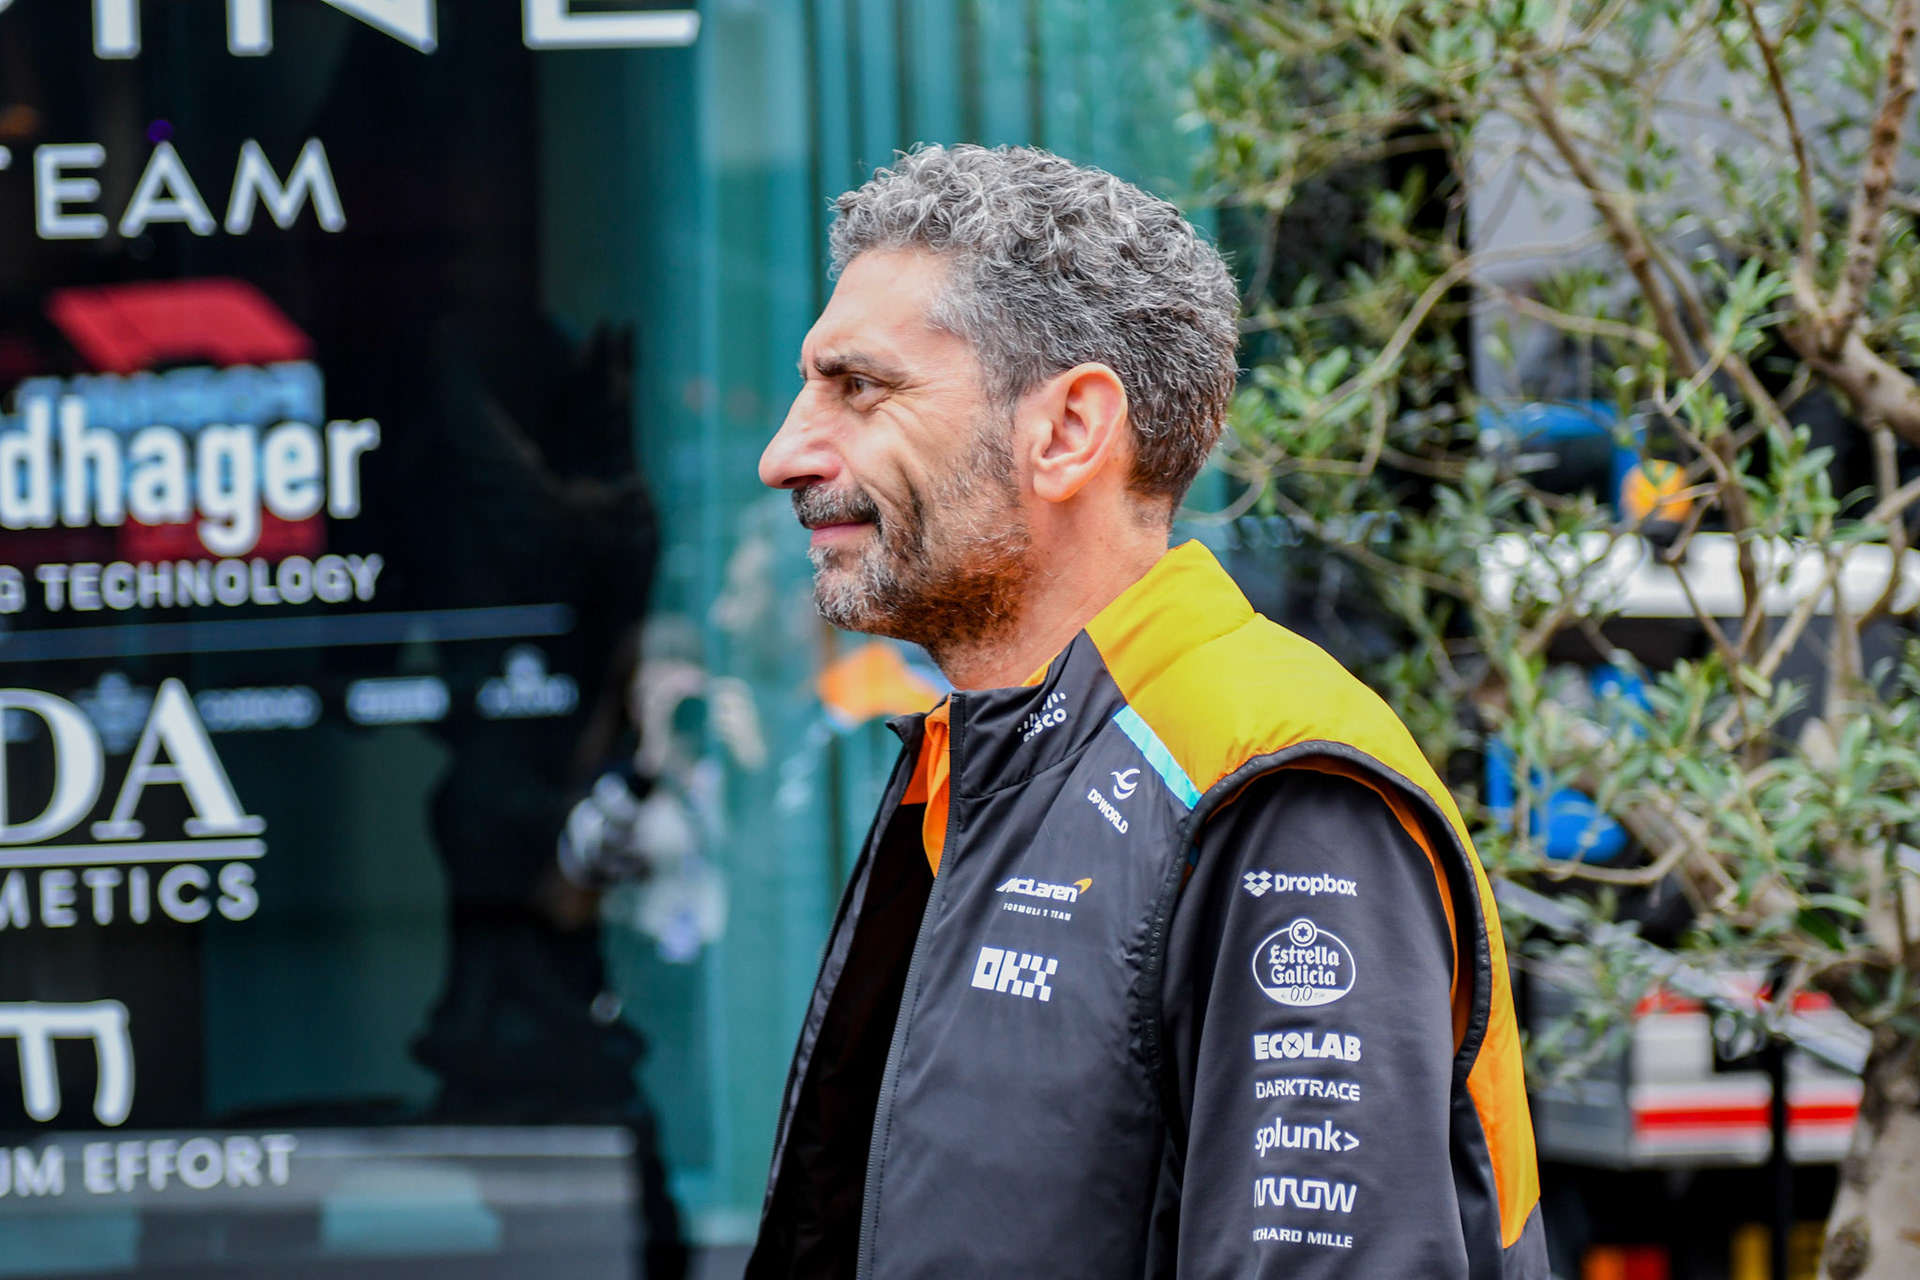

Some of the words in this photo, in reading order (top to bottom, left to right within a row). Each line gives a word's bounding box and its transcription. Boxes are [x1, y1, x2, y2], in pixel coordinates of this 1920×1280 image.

[0, 136, 346, 240] EAM
[35, 553, 384, 612] TECHNOLOGY
[1098, 797, 1129, 834] WORLD
[996, 877, 1079, 903] McLaren
[1275, 873, 1358, 897] Dropbox
[1043, 908, 1049, 918] 1
[1050, 910, 1072, 921] TEAM
[1268, 944, 1340, 967] Estrella
[971, 946, 1059, 1002] OKX
[1271, 965, 1337, 986] Galicia
[1254, 1032, 1361, 1062] ECOLAB
[1255, 1079, 1360, 1101] DARKTRACE
[83, 1134, 298, 1194] EFFORT
[1307, 1231, 1353, 1249] MILLE
